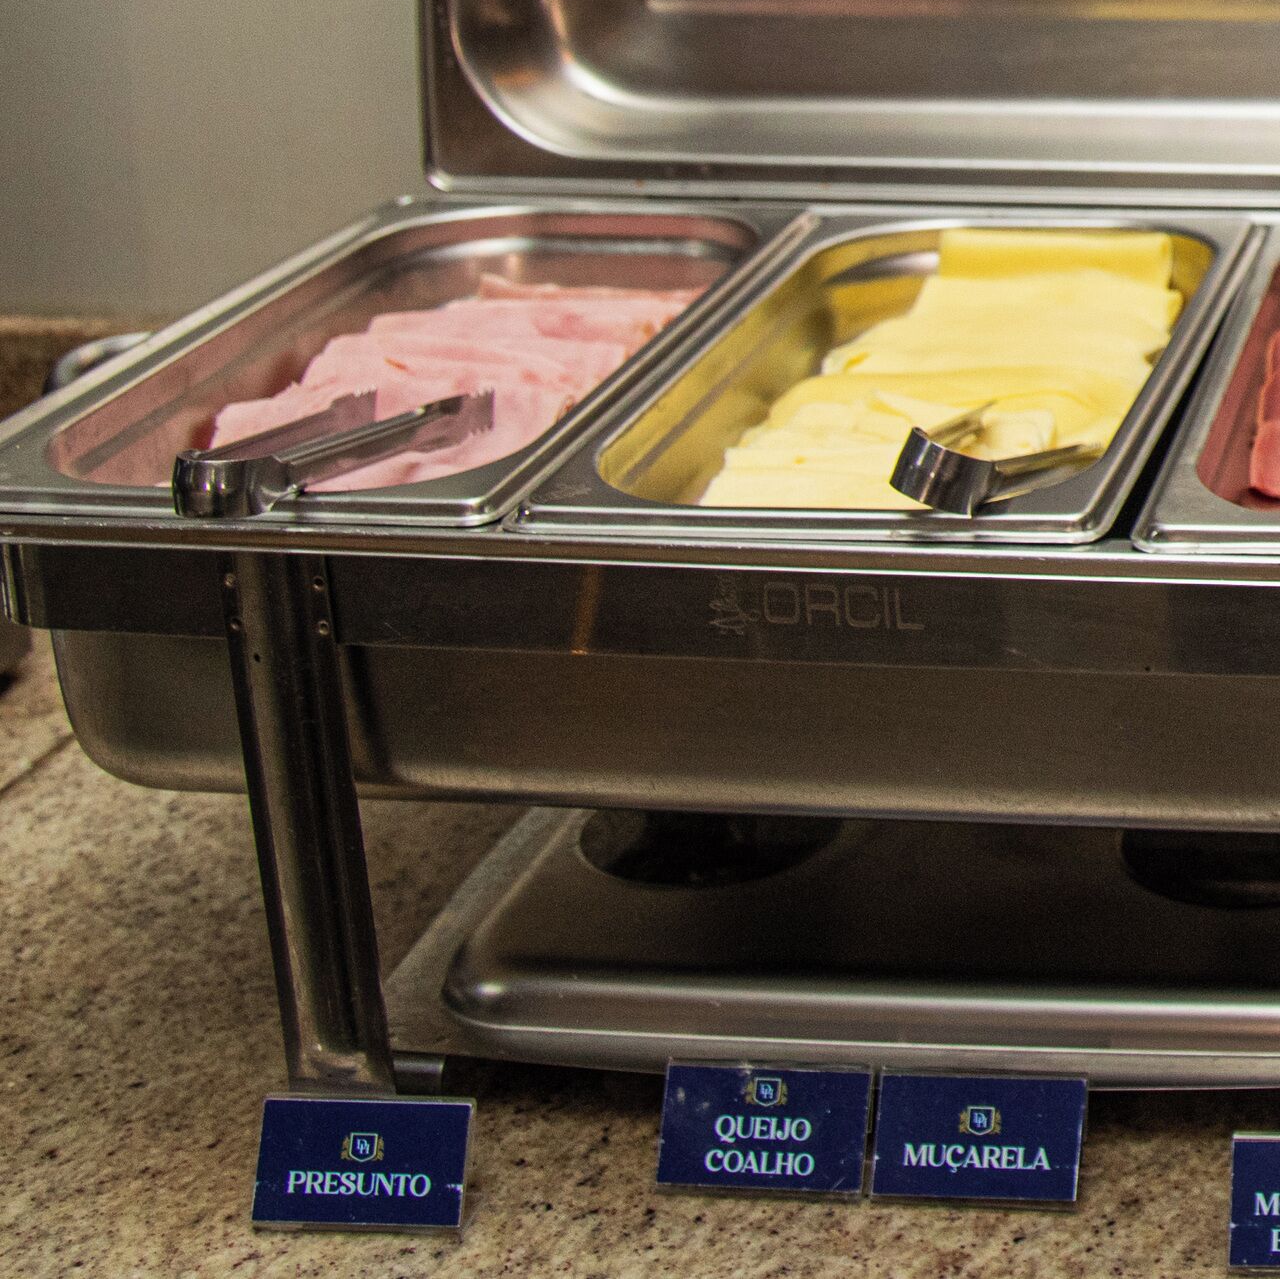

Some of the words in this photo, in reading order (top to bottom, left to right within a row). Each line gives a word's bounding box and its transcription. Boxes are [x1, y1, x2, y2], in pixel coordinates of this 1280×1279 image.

[763, 581, 925, 631] ORCIL
[714, 1114, 813, 1143] QUEIJO
[704, 1148, 815, 1176] COALHO
[903, 1143, 1051, 1173] MUÇARELA
[286, 1170, 432, 1198] PRESUNTO
